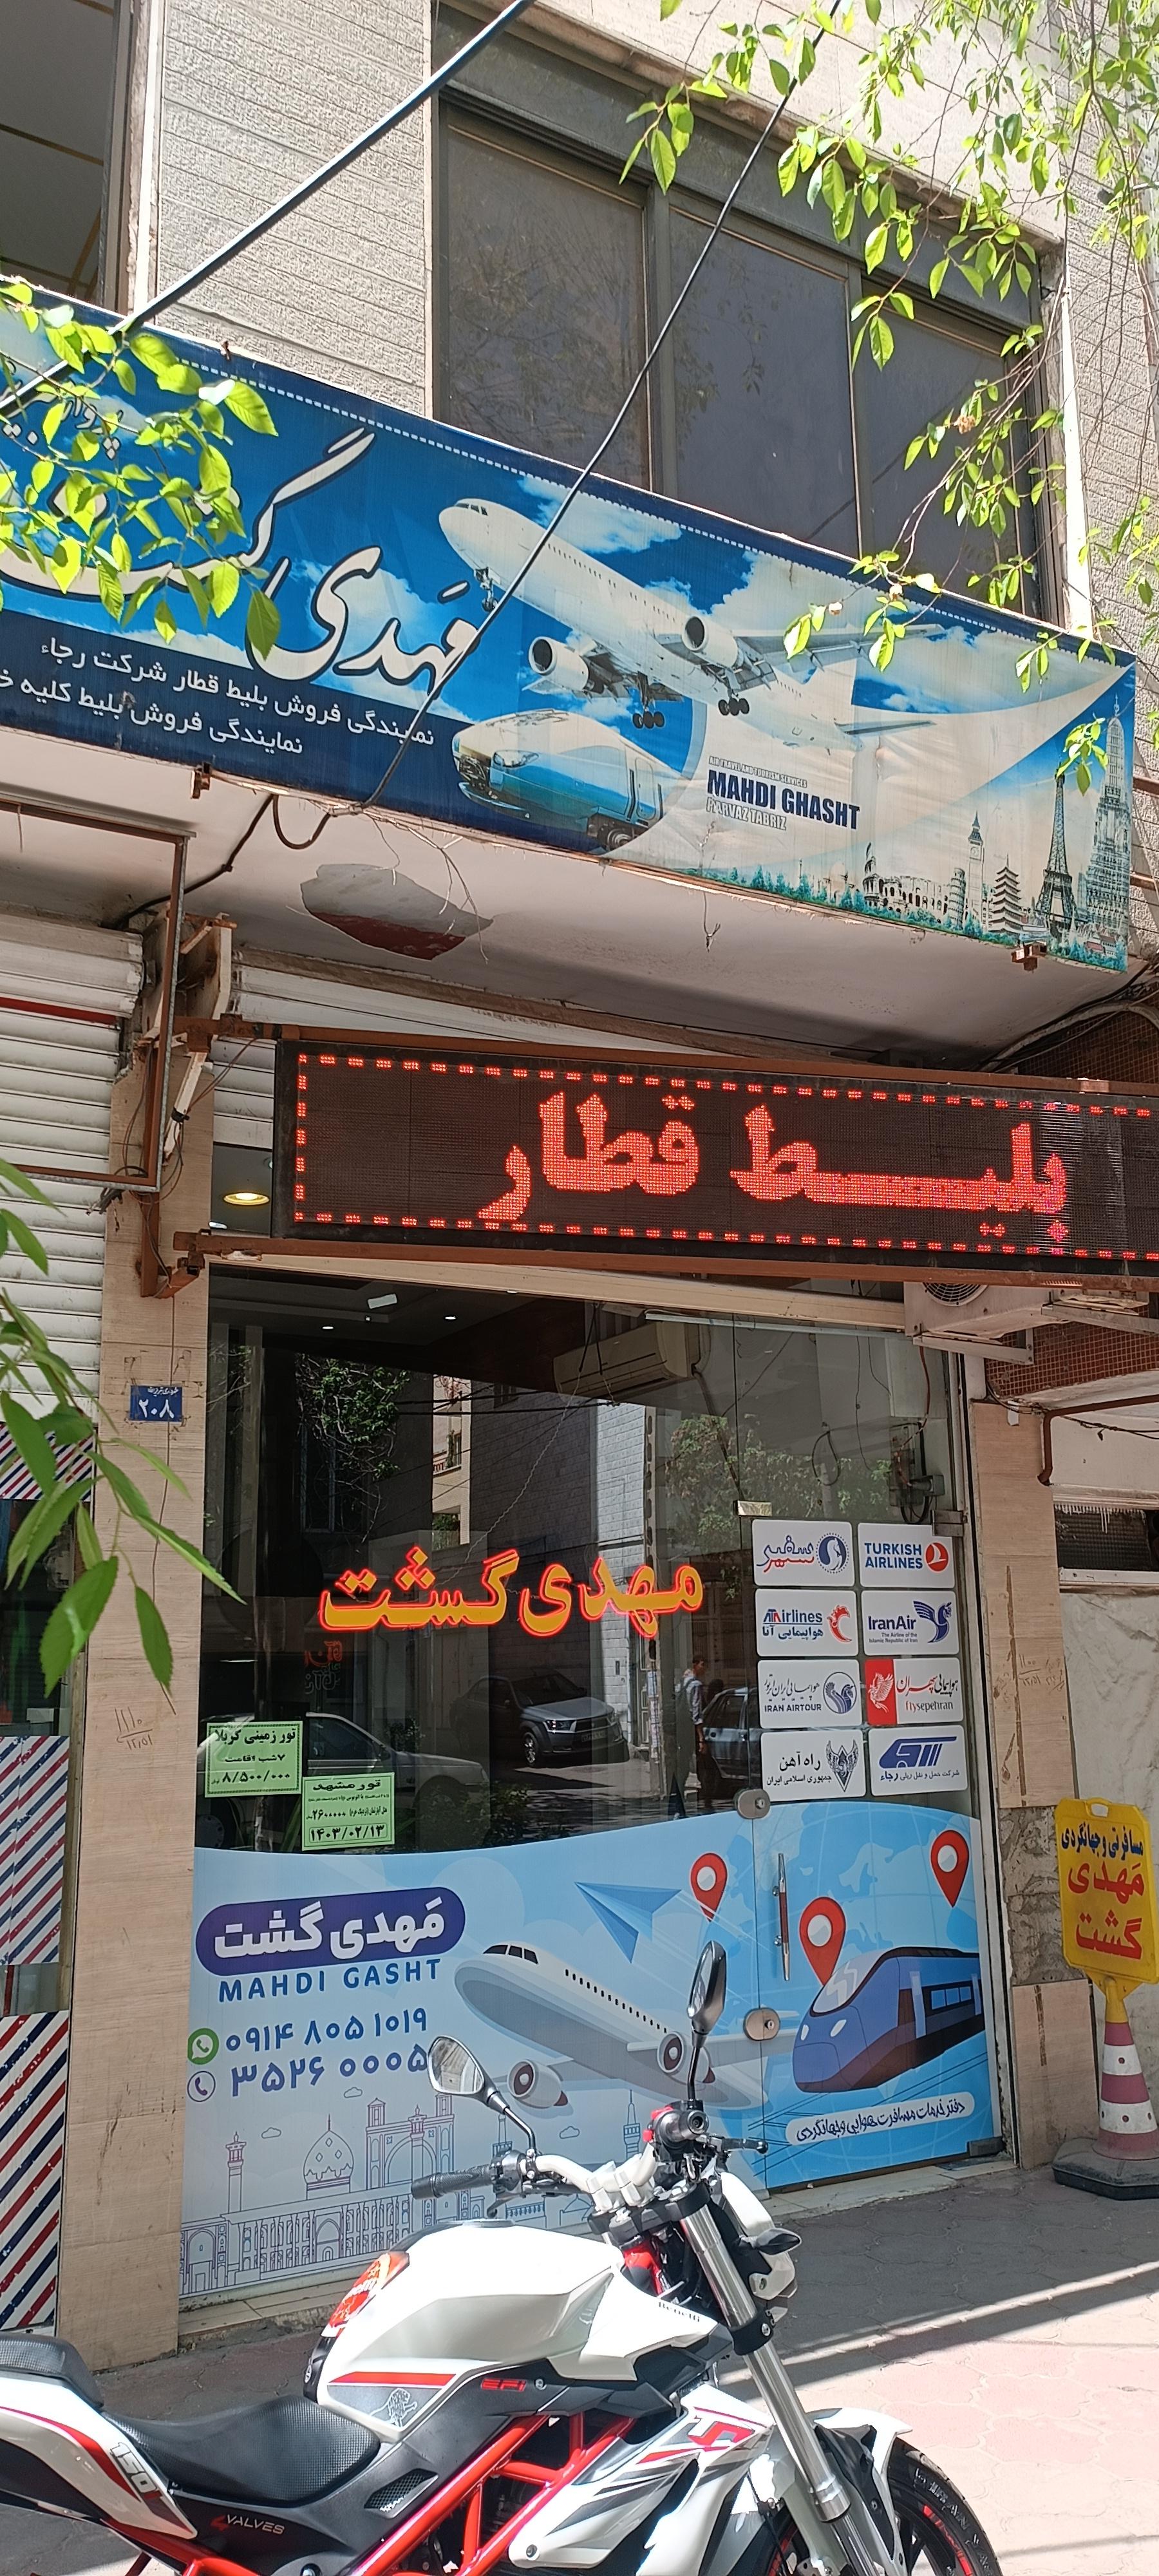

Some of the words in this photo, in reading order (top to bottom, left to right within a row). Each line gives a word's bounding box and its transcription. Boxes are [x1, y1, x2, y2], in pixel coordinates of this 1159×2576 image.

[93, 651, 167, 682] شرکت
[20, 680, 71, 704] کلیه
[173, 669, 219, 694] قطار
[77, 687, 124, 720] بلیط
[225, 679, 269, 711] بلیط
[130, 703, 203, 734] فروش
[274, 695, 341, 725] فروش
[209, 718, 303, 755] نمایندگی
[709, 755, 720, 766] AIR
[721, 759, 741, 772] TRAVEL
[742, 763, 754, 775] AND
[754, 767, 780, 782] TOURISM
[780, 773, 808, 789] SERVICES
[708, 769, 777, 810] MAHDI
[781, 788, 860, 829] GHASHT
[706, 797, 749, 822] PARVAZ
[749, 809, 787, 831] TABRIZ
[477, 1092, 701, 1222] قطار
[138, 1398, 174, 1419] ۲۰۸
[864, 1542, 922, 1555] TURKISH
[865, 1557, 923, 1569] AIRLINES
[318, 1545, 520, 1632] گشت
[517, 1555, 704, 1639] مهدی
[778, 1626, 824, 1640] هواپیمایی
[764, 1705, 784, 1713] IRAN
[786, 1703, 822, 1712] AIRTOUR
[214, 1729, 241, 1745] کربلا
[244, 1730, 276, 1745] زمینی
[279, 1728, 296, 1744] تور
[780, 1751, 800, 1771] آهن
[804, 1753, 821, 1771] راه
[313, 1781, 355, 1792] مشهد
[356, 1779, 381, 1791] تور
[766, 1776, 782, 1785] ایران
[783, 1774, 806, 1785] اسلامی
[1061, 1821, 1100, 1858] جهانگردی
[1108, 1824, 1144, 1861] مسافرتی
[214, 1901, 324, 1958] گشت
[1075, 1909, 1143, 1960] گشت
[219, 1971, 325, 2003] MAHDI
[343, 1958, 441, 1989] GASHT
[877, 2107, 916, 2127] مسافرت
[916, 2099, 946, 2119] خدمات
[945, 2098, 965, 2117] دفتر
[847, 2113, 878, 2135] هوایی
[480, 2378, 527, 2392] EFI
